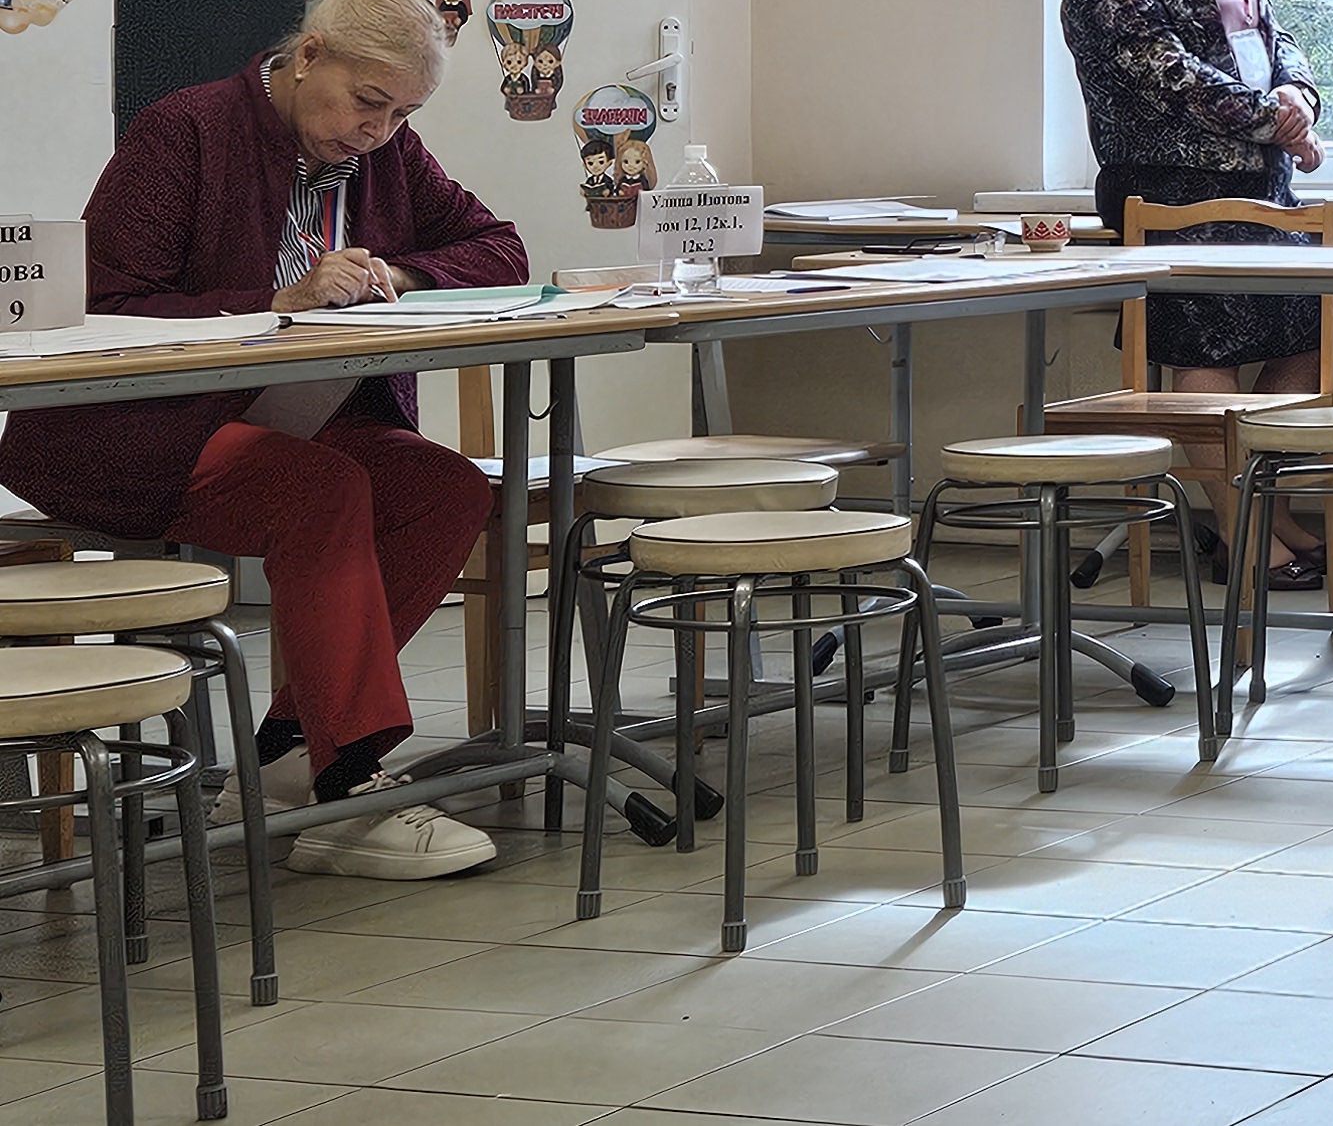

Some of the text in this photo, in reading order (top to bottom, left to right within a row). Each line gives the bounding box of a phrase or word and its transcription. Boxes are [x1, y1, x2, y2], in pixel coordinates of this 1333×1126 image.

[652, 192, 751, 209] Улица Изотова
[656, 222, 680, 233] дом
[682, 238, 714, 254] 12к.2
[9, 299, 25, 325] 9
